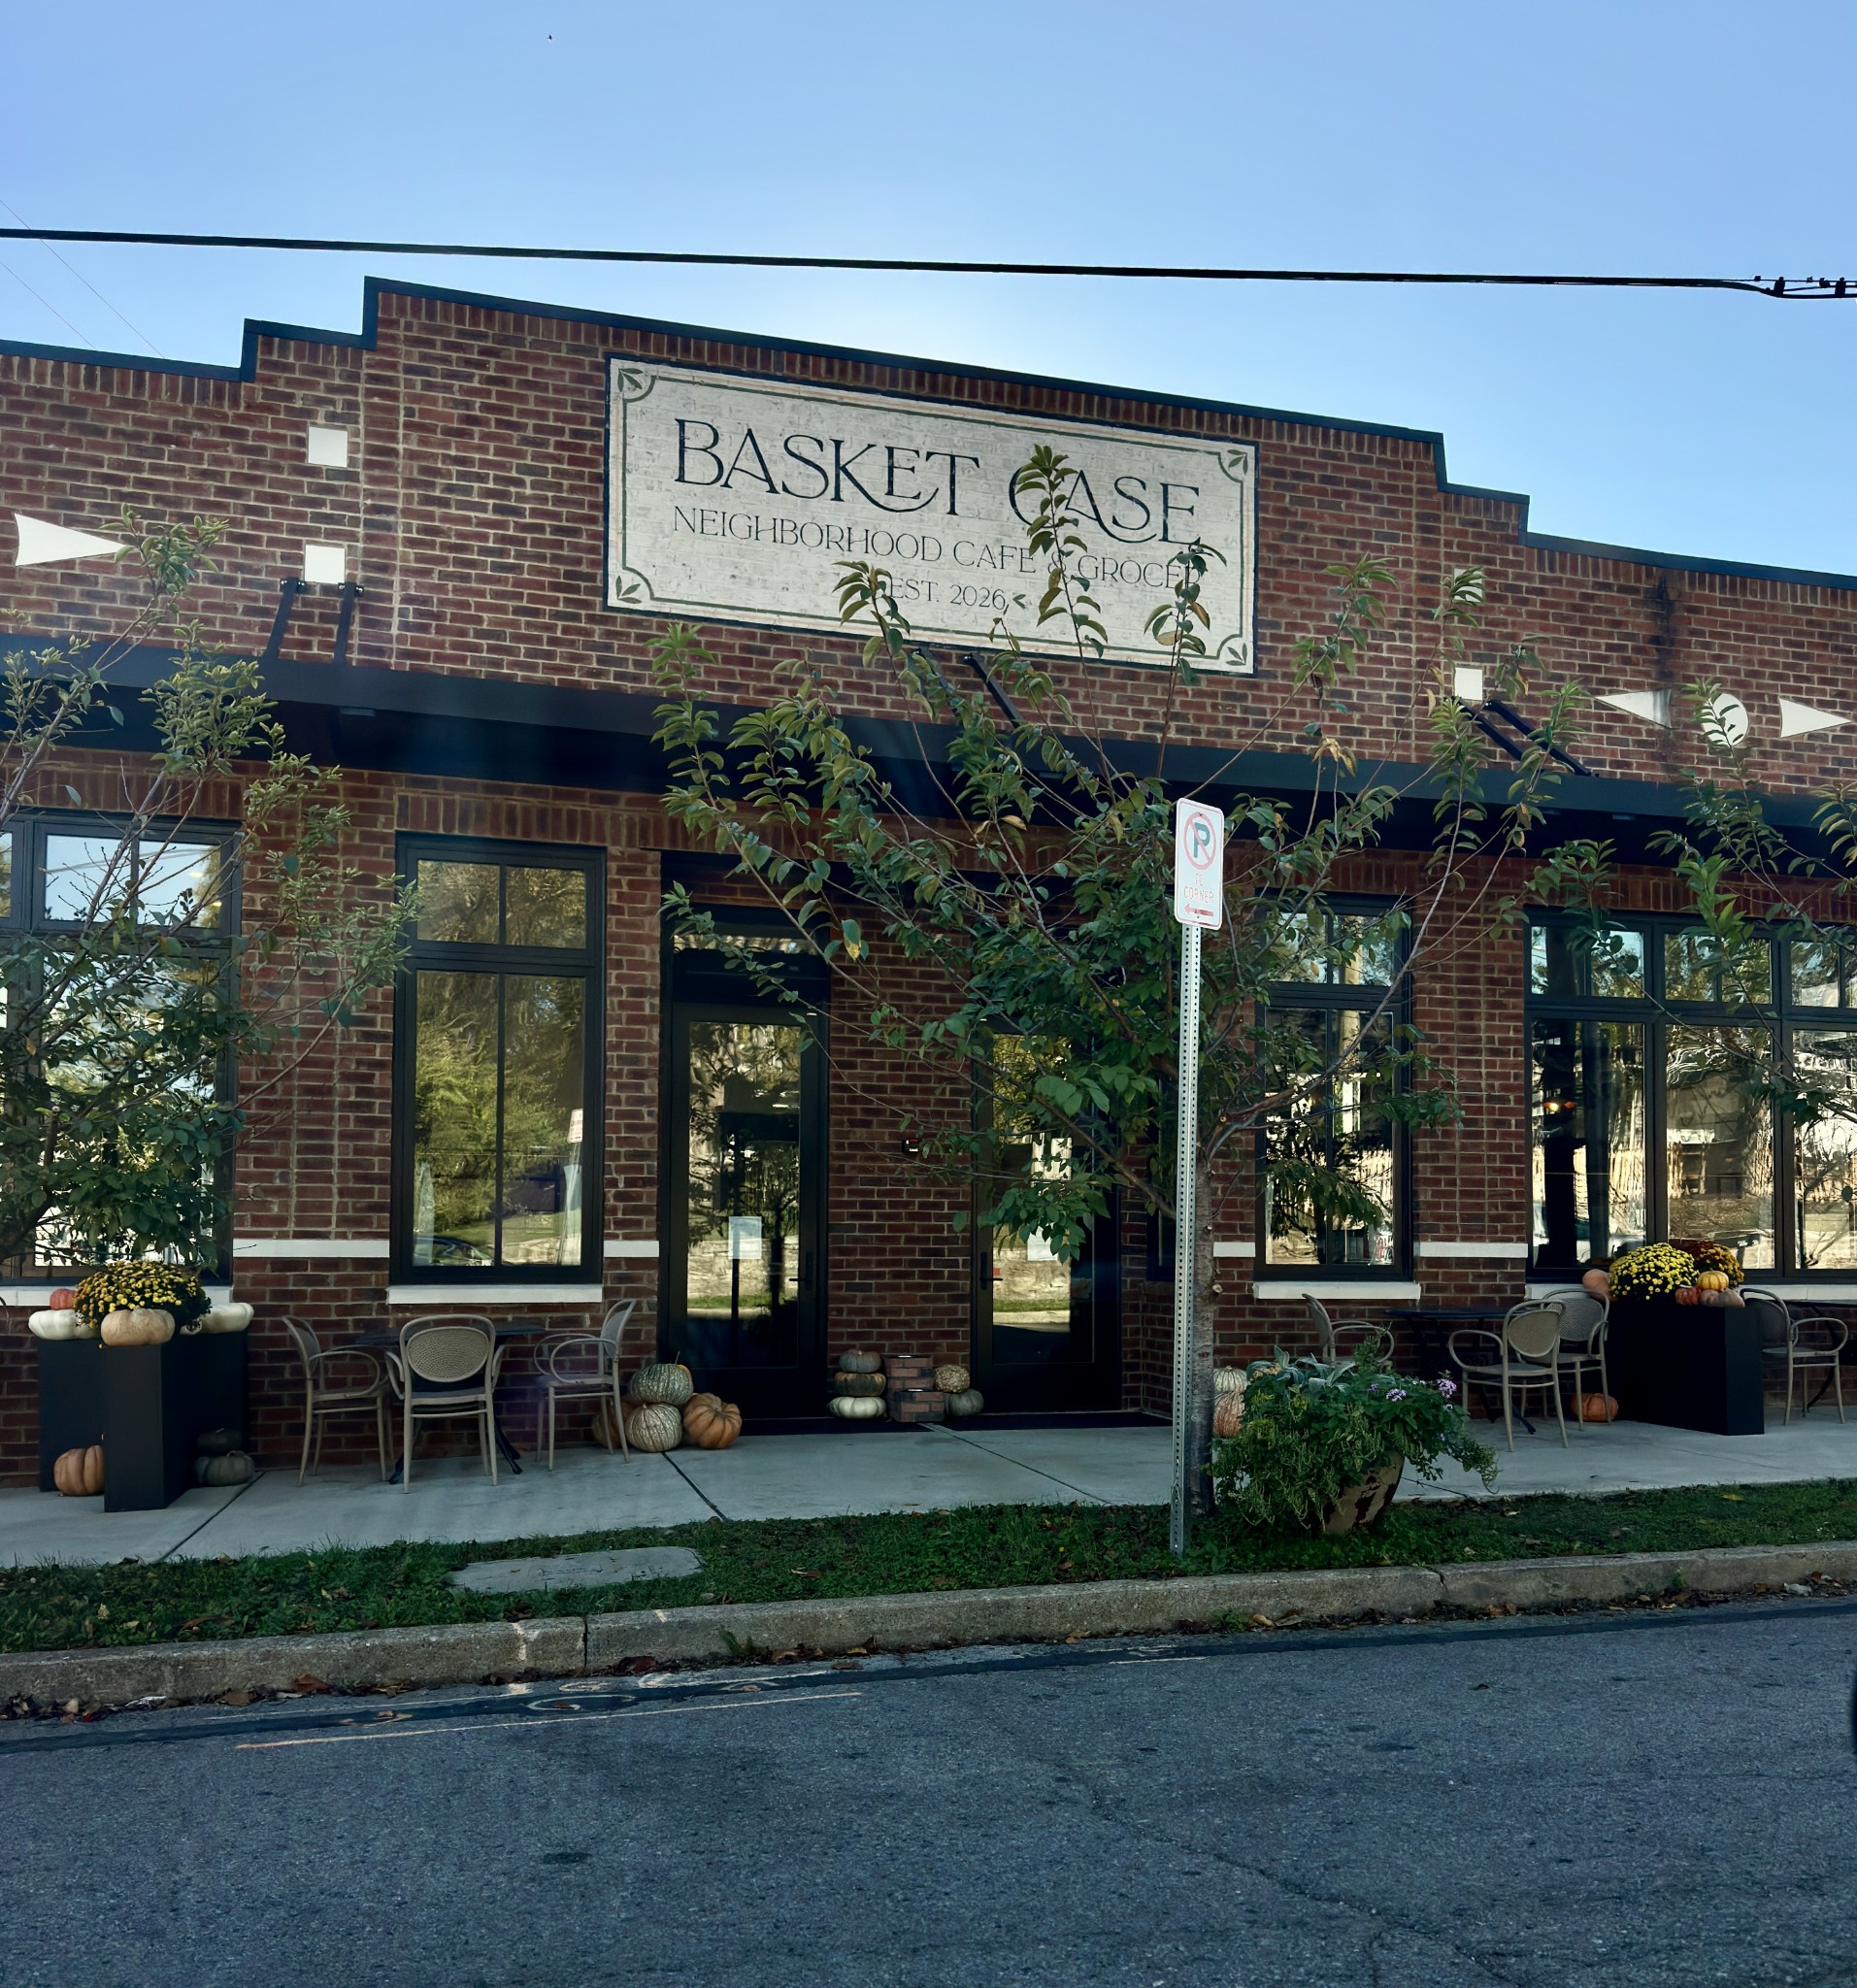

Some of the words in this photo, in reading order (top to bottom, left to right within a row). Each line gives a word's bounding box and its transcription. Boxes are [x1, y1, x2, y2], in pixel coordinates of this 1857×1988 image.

[674, 418, 980, 515] BASKET
[1008, 465, 1202, 546] CASE
[674, 505, 943, 562] NEIGHBORHOOD
[952, 540, 1037, 574] CAFE
[889, 577, 940, 603] EST.
[949, 583, 1007, 611] 2026
[1183, 885, 1214, 904] CORNER
[1195, 873, 1205, 887] TO
